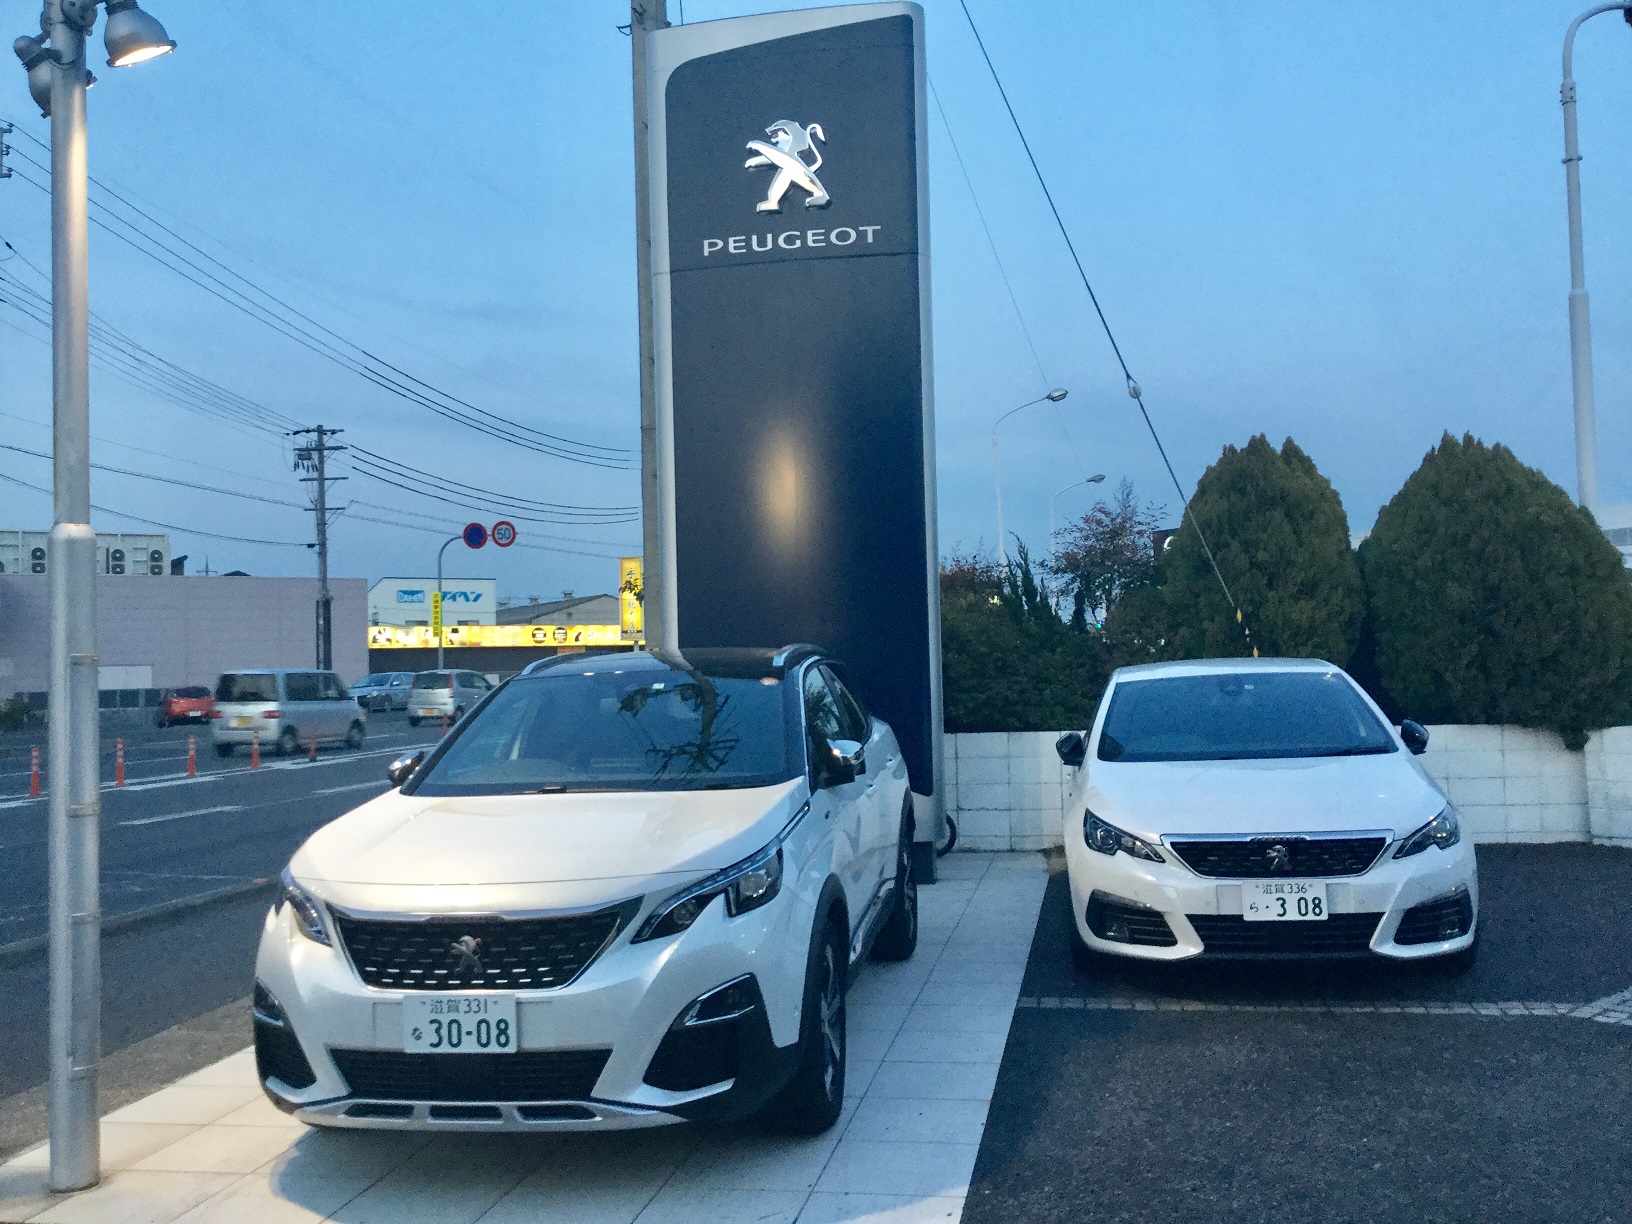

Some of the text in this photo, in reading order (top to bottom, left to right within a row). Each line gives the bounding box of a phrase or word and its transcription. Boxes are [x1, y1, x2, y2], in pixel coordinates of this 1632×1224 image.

[703, 225, 882, 256] PEUGEOT
[496, 527, 512, 540] 50
[428, 1018, 510, 1048] 30-08
